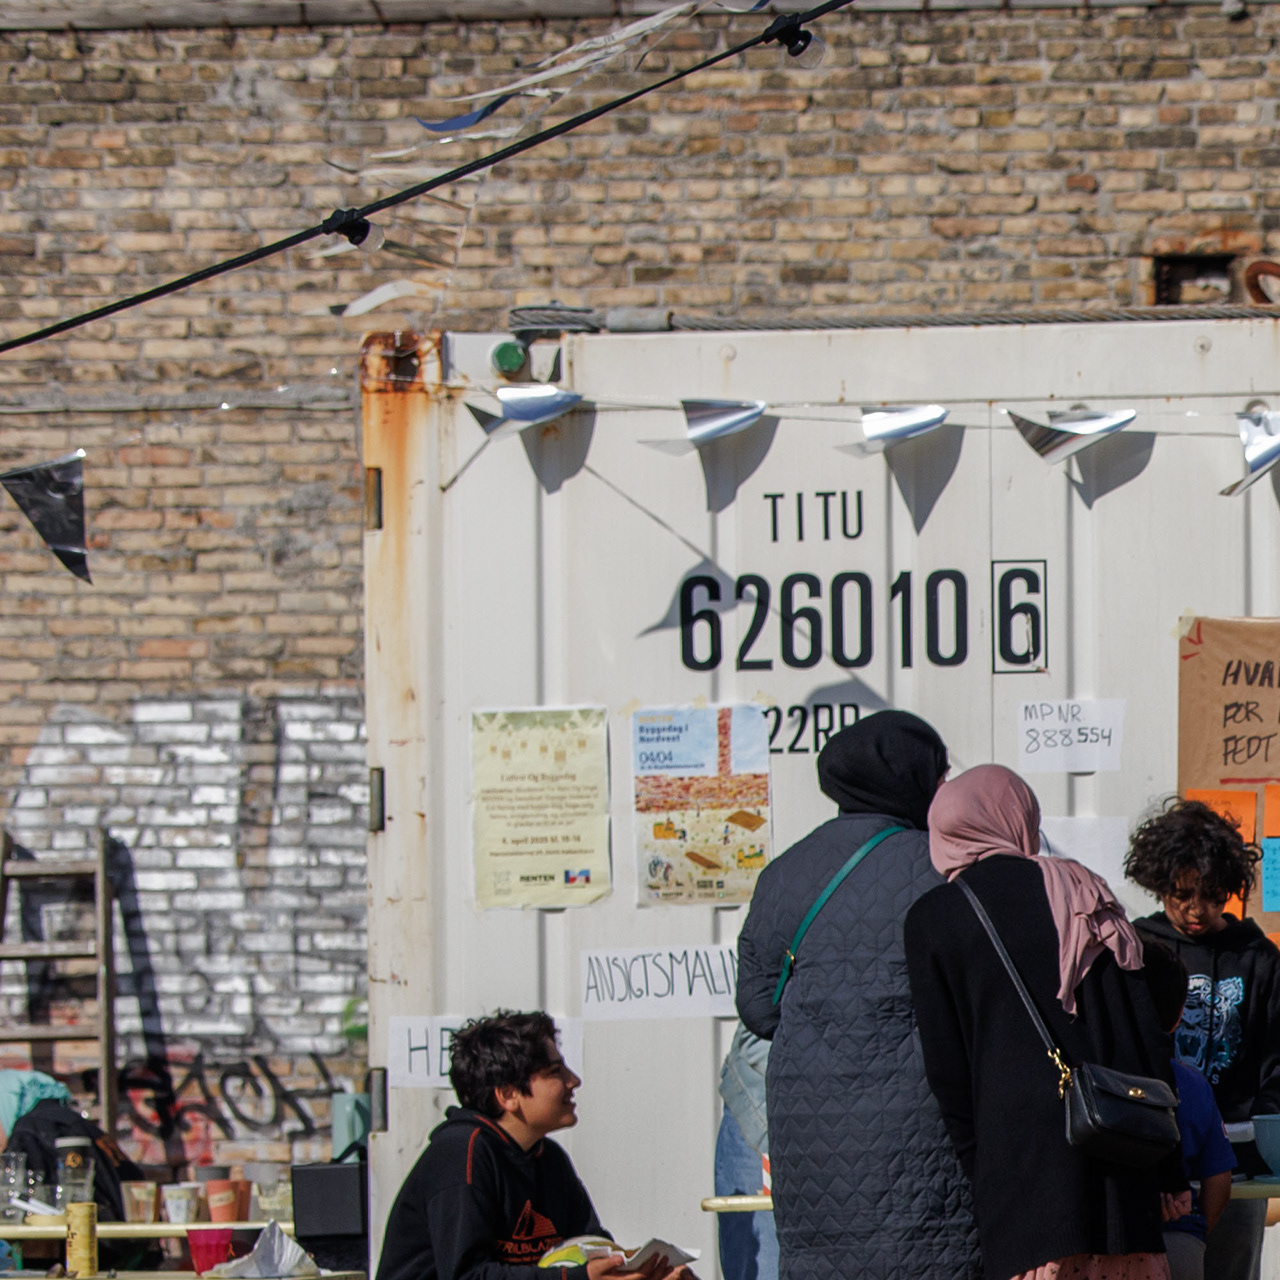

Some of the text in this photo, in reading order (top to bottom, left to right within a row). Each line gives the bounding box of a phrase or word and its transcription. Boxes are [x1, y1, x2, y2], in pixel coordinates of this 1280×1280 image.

[763, 490, 863, 542] TITU
[680, 567, 969, 672] 626010
[1025, 727, 1113, 753] 888554
[1222, 732, 1278, 766] FEDT
